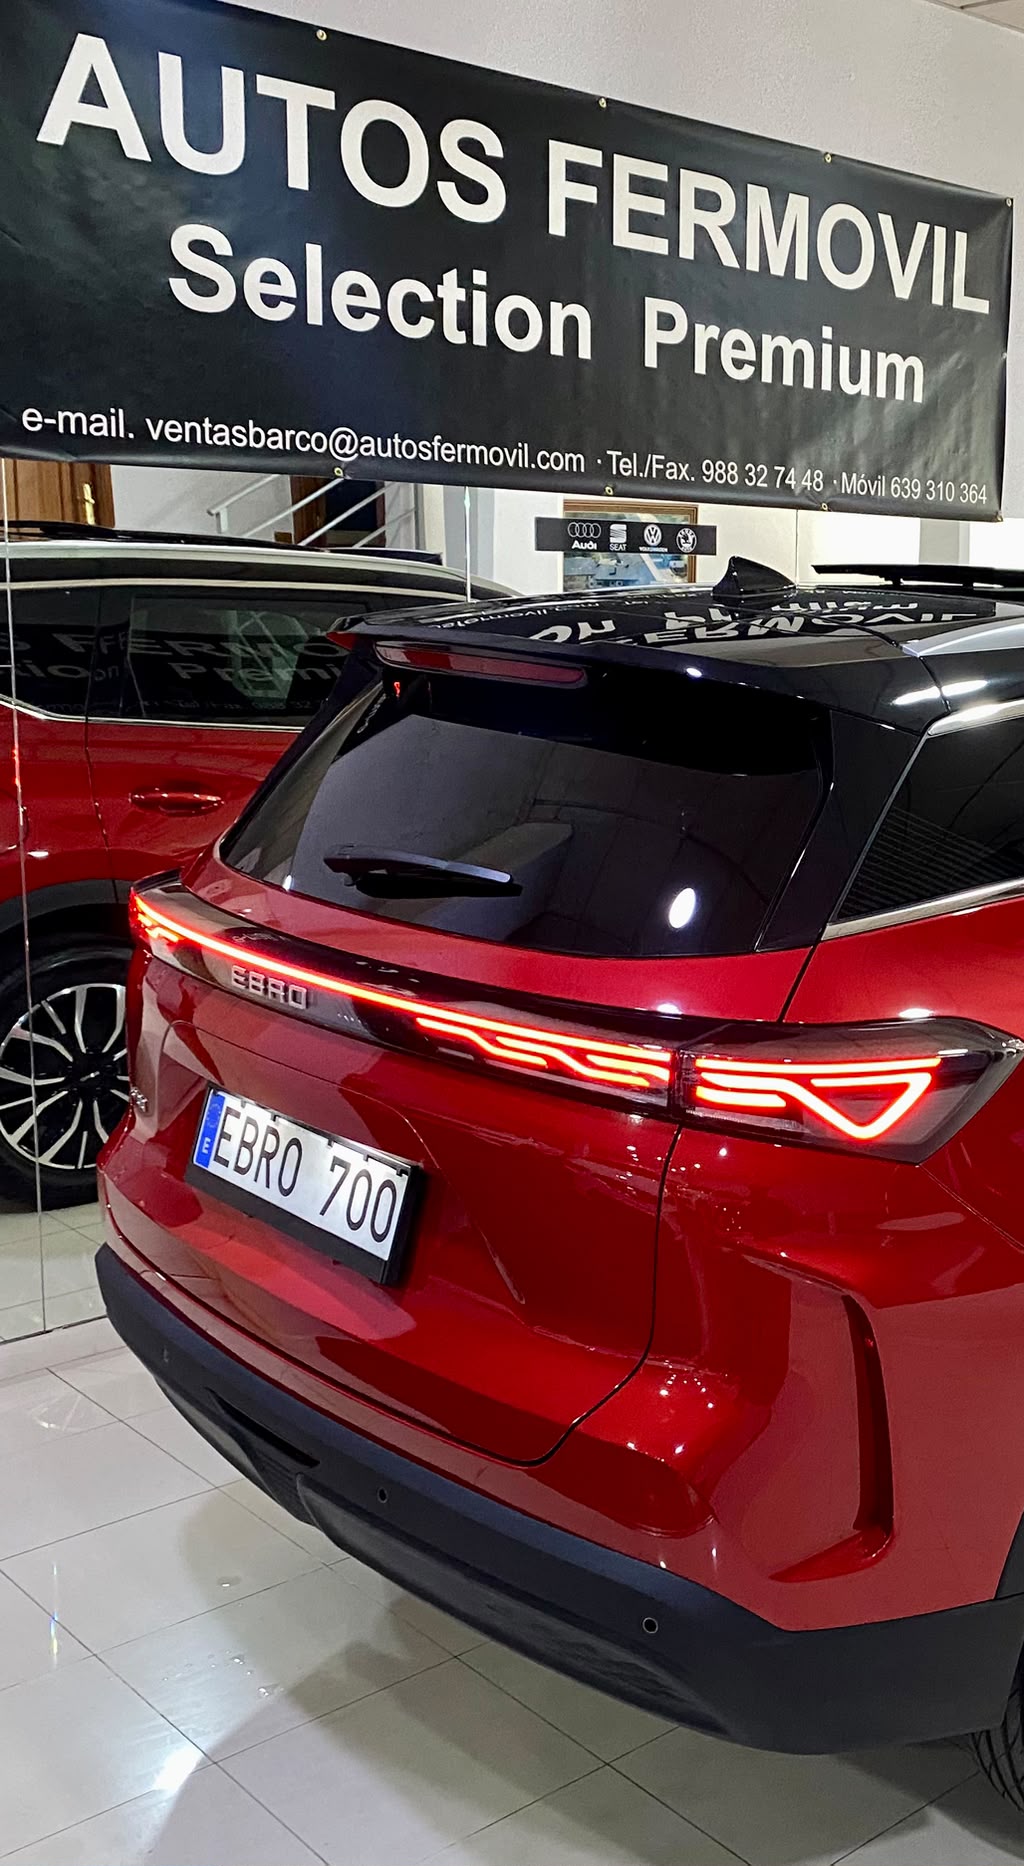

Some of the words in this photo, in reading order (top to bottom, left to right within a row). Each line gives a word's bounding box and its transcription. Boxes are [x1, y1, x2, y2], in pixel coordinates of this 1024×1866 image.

[36, 33, 507, 223] AUTOS
[548, 139, 990, 315] FERMOVIL
[169, 223, 592, 360] Selection
[644, 296, 924, 405] Premium
[22, 407, 135, 439] e-mail.
[145, 416, 585, 473] ventasbarco@autosfermovil.com
[606, 450, 696, 482] Tel./Fax.
[702, 459, 739, 485] 988
[744, 463, 768, 488] 32
[773, 465, 796, 490] 74
[801, 468, 824, 492] 48
[841, 471, 886, 497] Móvil
[890, 476, 922, 500] 639
[926, 479, 956, 502] 310
[959, 482, 988, 505] 364
[571, 539, 598, 550] Audi
[609, 543, 628, 551] SEAT
[231, 964, 307, 1010] EBRO
[202, 1137, 211, 1154] E
[213, 1106, 303, 1197] EBRO
[319, 1155, 398, 1243] 700
